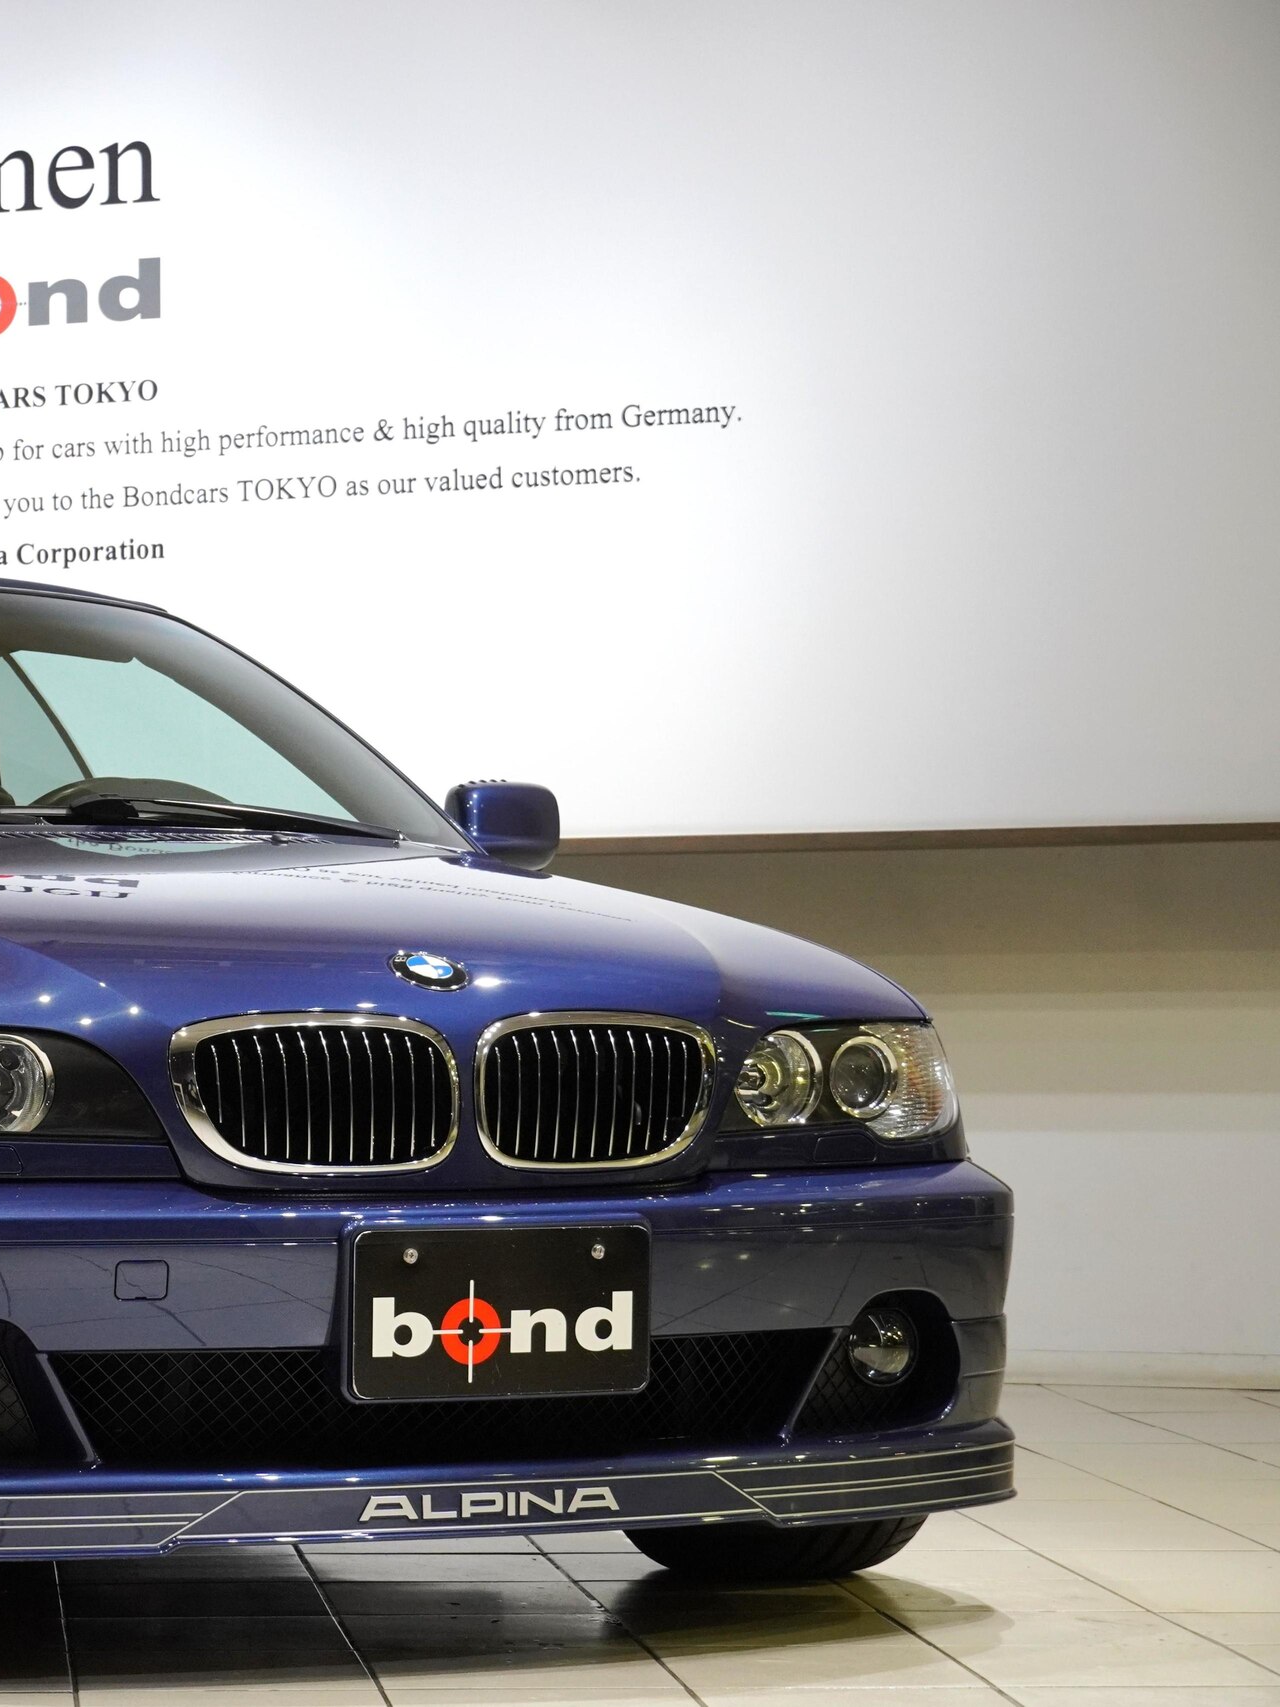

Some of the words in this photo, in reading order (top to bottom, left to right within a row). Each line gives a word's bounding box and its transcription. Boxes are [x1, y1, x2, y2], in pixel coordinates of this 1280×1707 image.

[55, 379, 159, 408] TOKYO
[12, 438, 45, 462] for
[51, 439, 96, 460] cars
[103, 431, 153, 456] with
[160, 428, 211, 458] high
[218, 423, 365, 456] performance
[372, 418, 395, 442] &
[402, 414, 456, 445] high
[463, 409, 547, 443] quality
[553, 407, 614, 434] from
[621, 402, 743, 431] Germany.
[3, 496, 45, 520] you
[51, 493, 73, 512] to
[80, 487, 115, 511] the
[122, 482, 229, 508] Bondcars
[236, 474, 337, 502] TOKYO
[345, 479, 370, 497] as
[377, 473, 417, 497] our
[424, 466, 504, 494] valued
[511, 464, 641, 490] customers.
[16, 538, 165, 569] Corporation
[372, 1291, 634, 1366] bond
[358, 1486, 620, 1522] ALPINA
